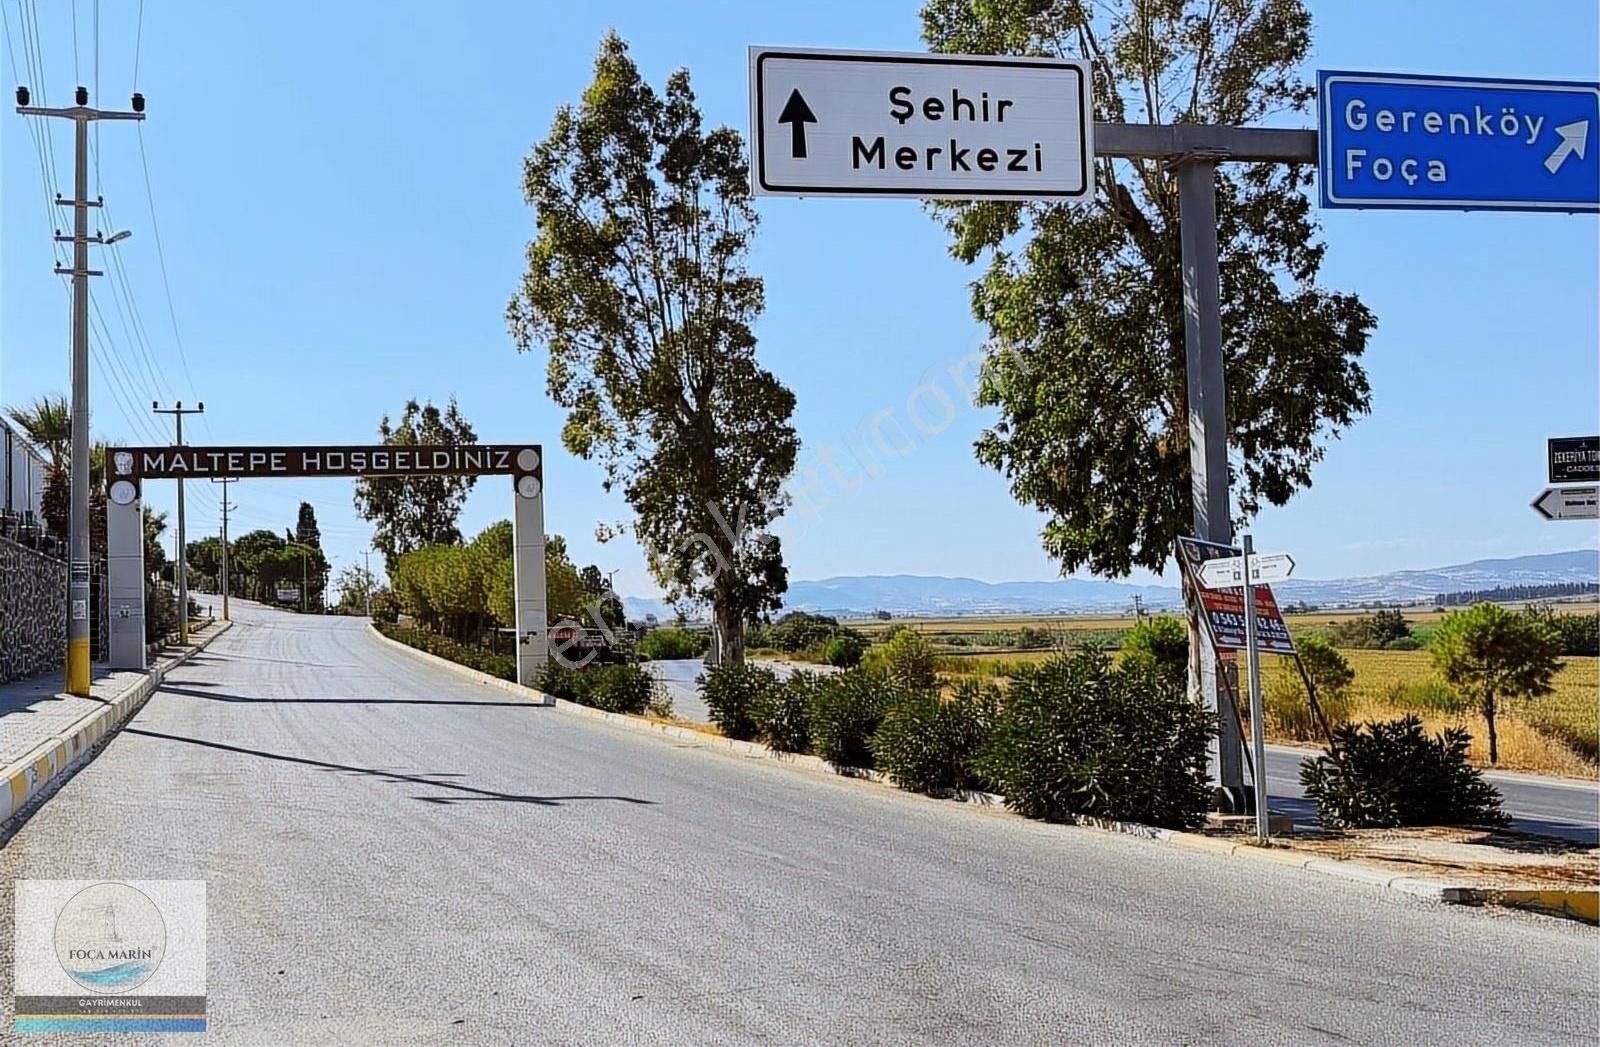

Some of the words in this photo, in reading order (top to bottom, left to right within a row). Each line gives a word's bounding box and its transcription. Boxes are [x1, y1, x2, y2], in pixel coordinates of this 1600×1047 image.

[888, 86, 1013, 125] Şehir
[1344, 99, 1544, 145] Gerenköy
[852, 136, 1042, 172] Merkezi
[1346, 149, 1446, 186] Foça
[143, 452, 287, 472] MALTEPE
[302, 446, 510, 473] HOŞGELDİNİZ
